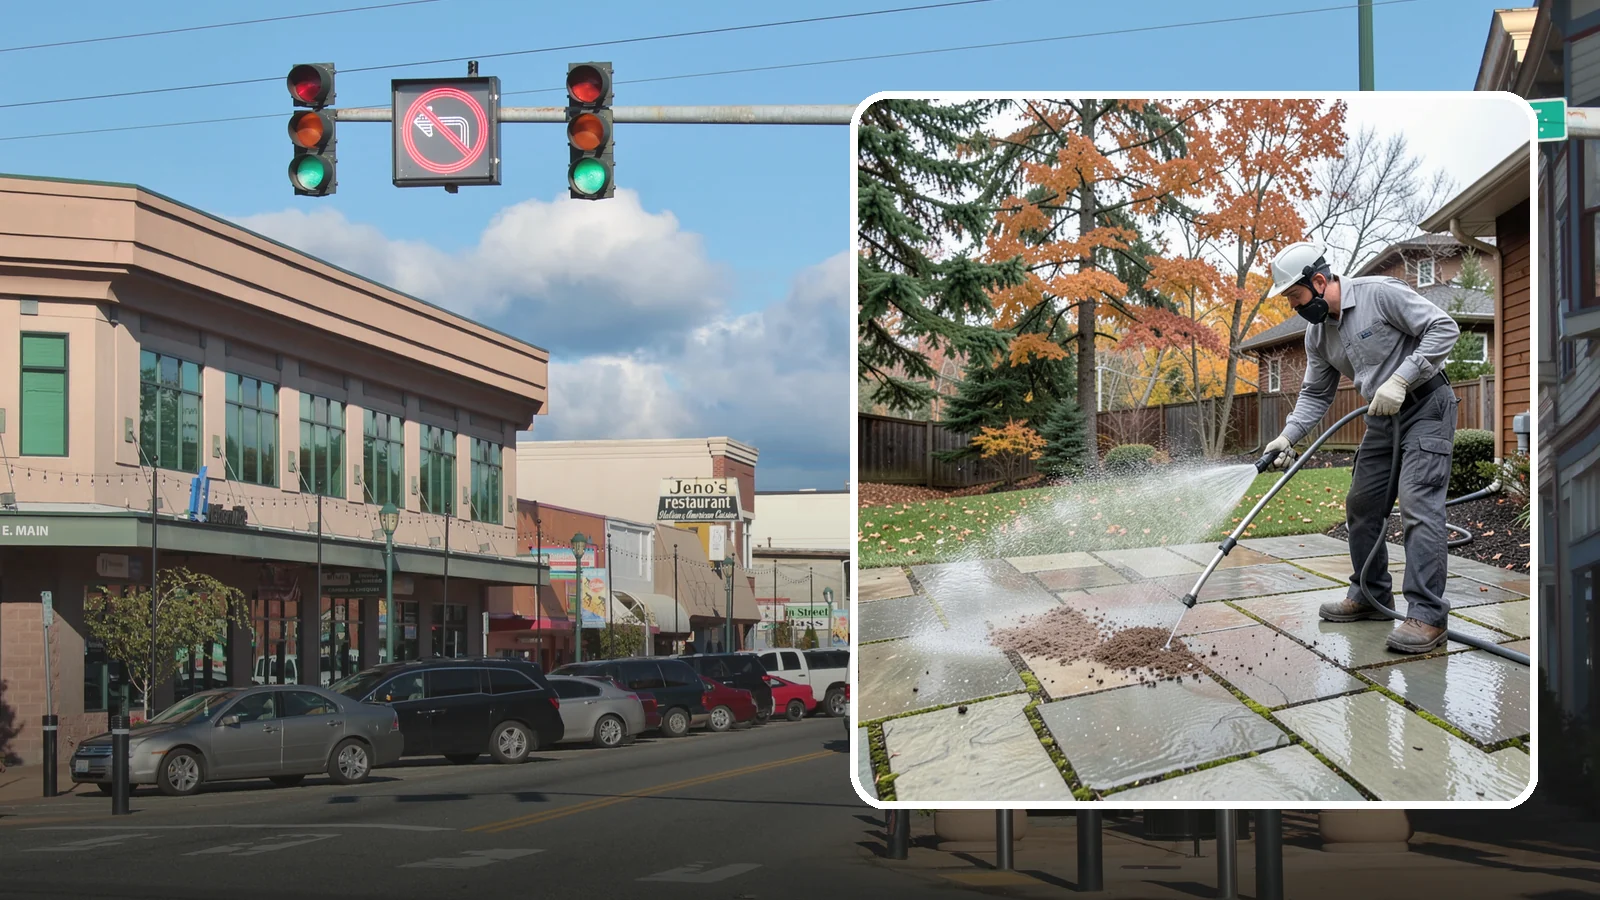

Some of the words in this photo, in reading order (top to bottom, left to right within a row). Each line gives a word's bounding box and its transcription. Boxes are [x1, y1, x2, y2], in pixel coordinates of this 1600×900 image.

[669, 480, 727, 494] Jeno's
[665, 496, 731, 509] restaurant
[658, 509, 681, 519] Italian
[685, 509, 714, 519] American
[715, 509, 738, 519] Cuisine
[2, 525, 13, 536] E.
[15, 525, 49, 536] MAIN
[785, 607, 795, 617] in
[797, 607, 828, 617] Street
[790, 619, 823, 627] lass
